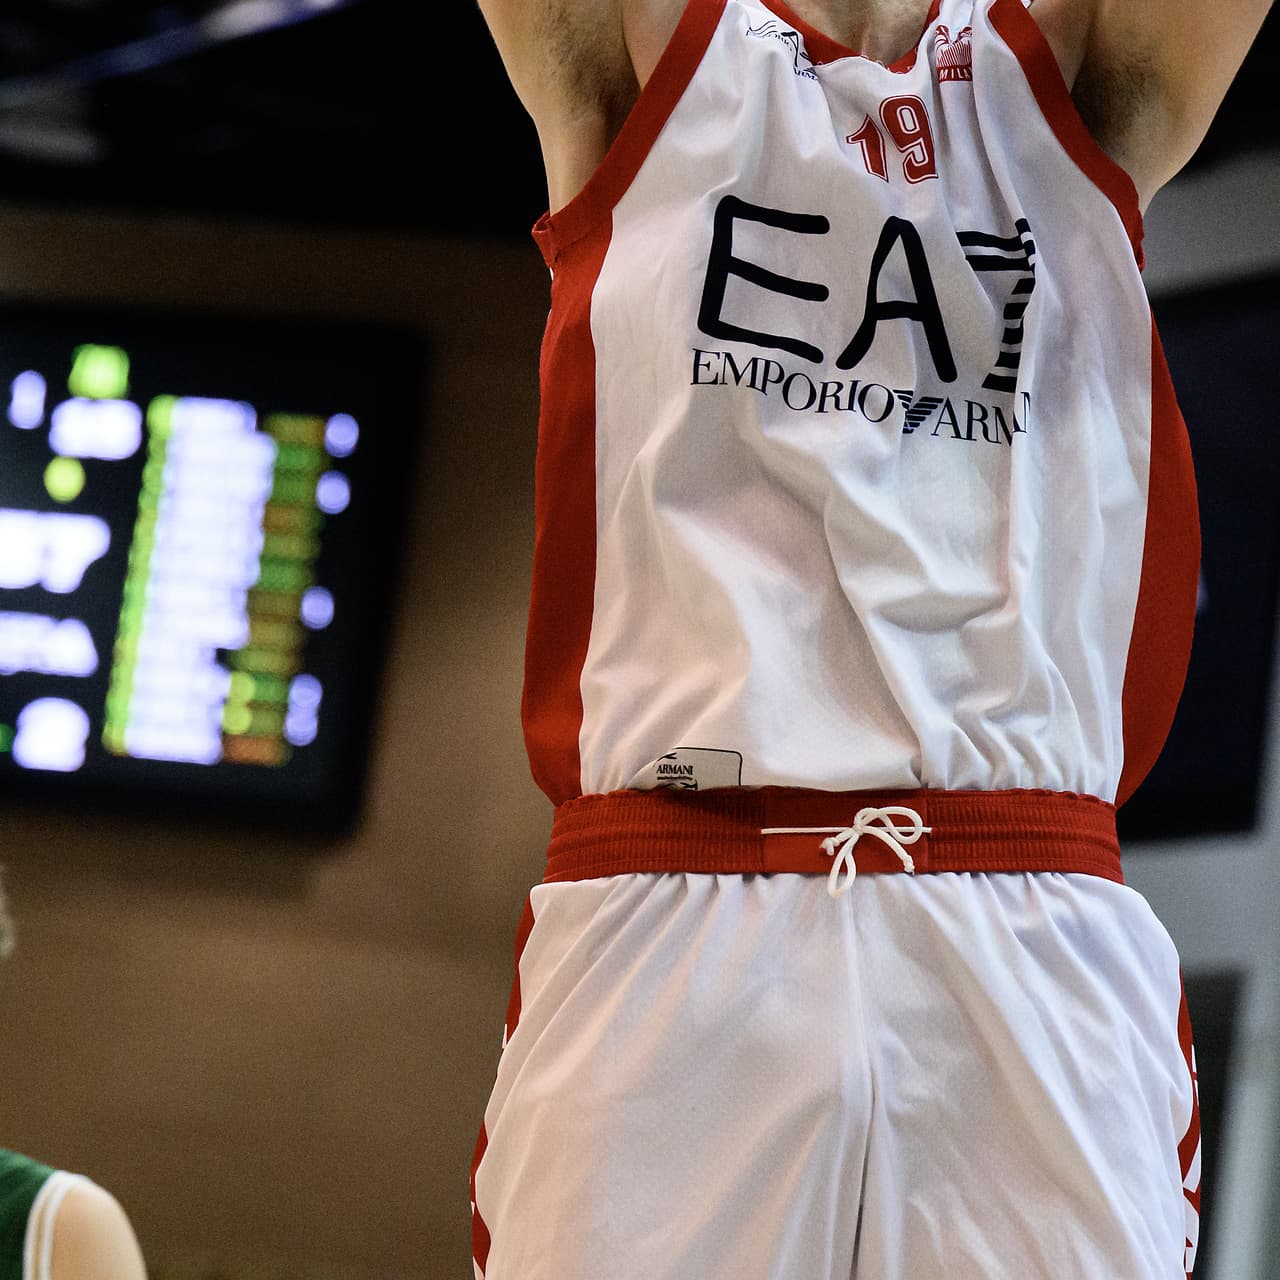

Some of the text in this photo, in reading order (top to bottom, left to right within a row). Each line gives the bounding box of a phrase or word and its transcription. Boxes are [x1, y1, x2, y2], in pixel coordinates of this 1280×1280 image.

[846, 94, 939, 184] 19
[690, 348, 896, 423] EMPORIO
[656, 763, 694, 776] ARMANI
